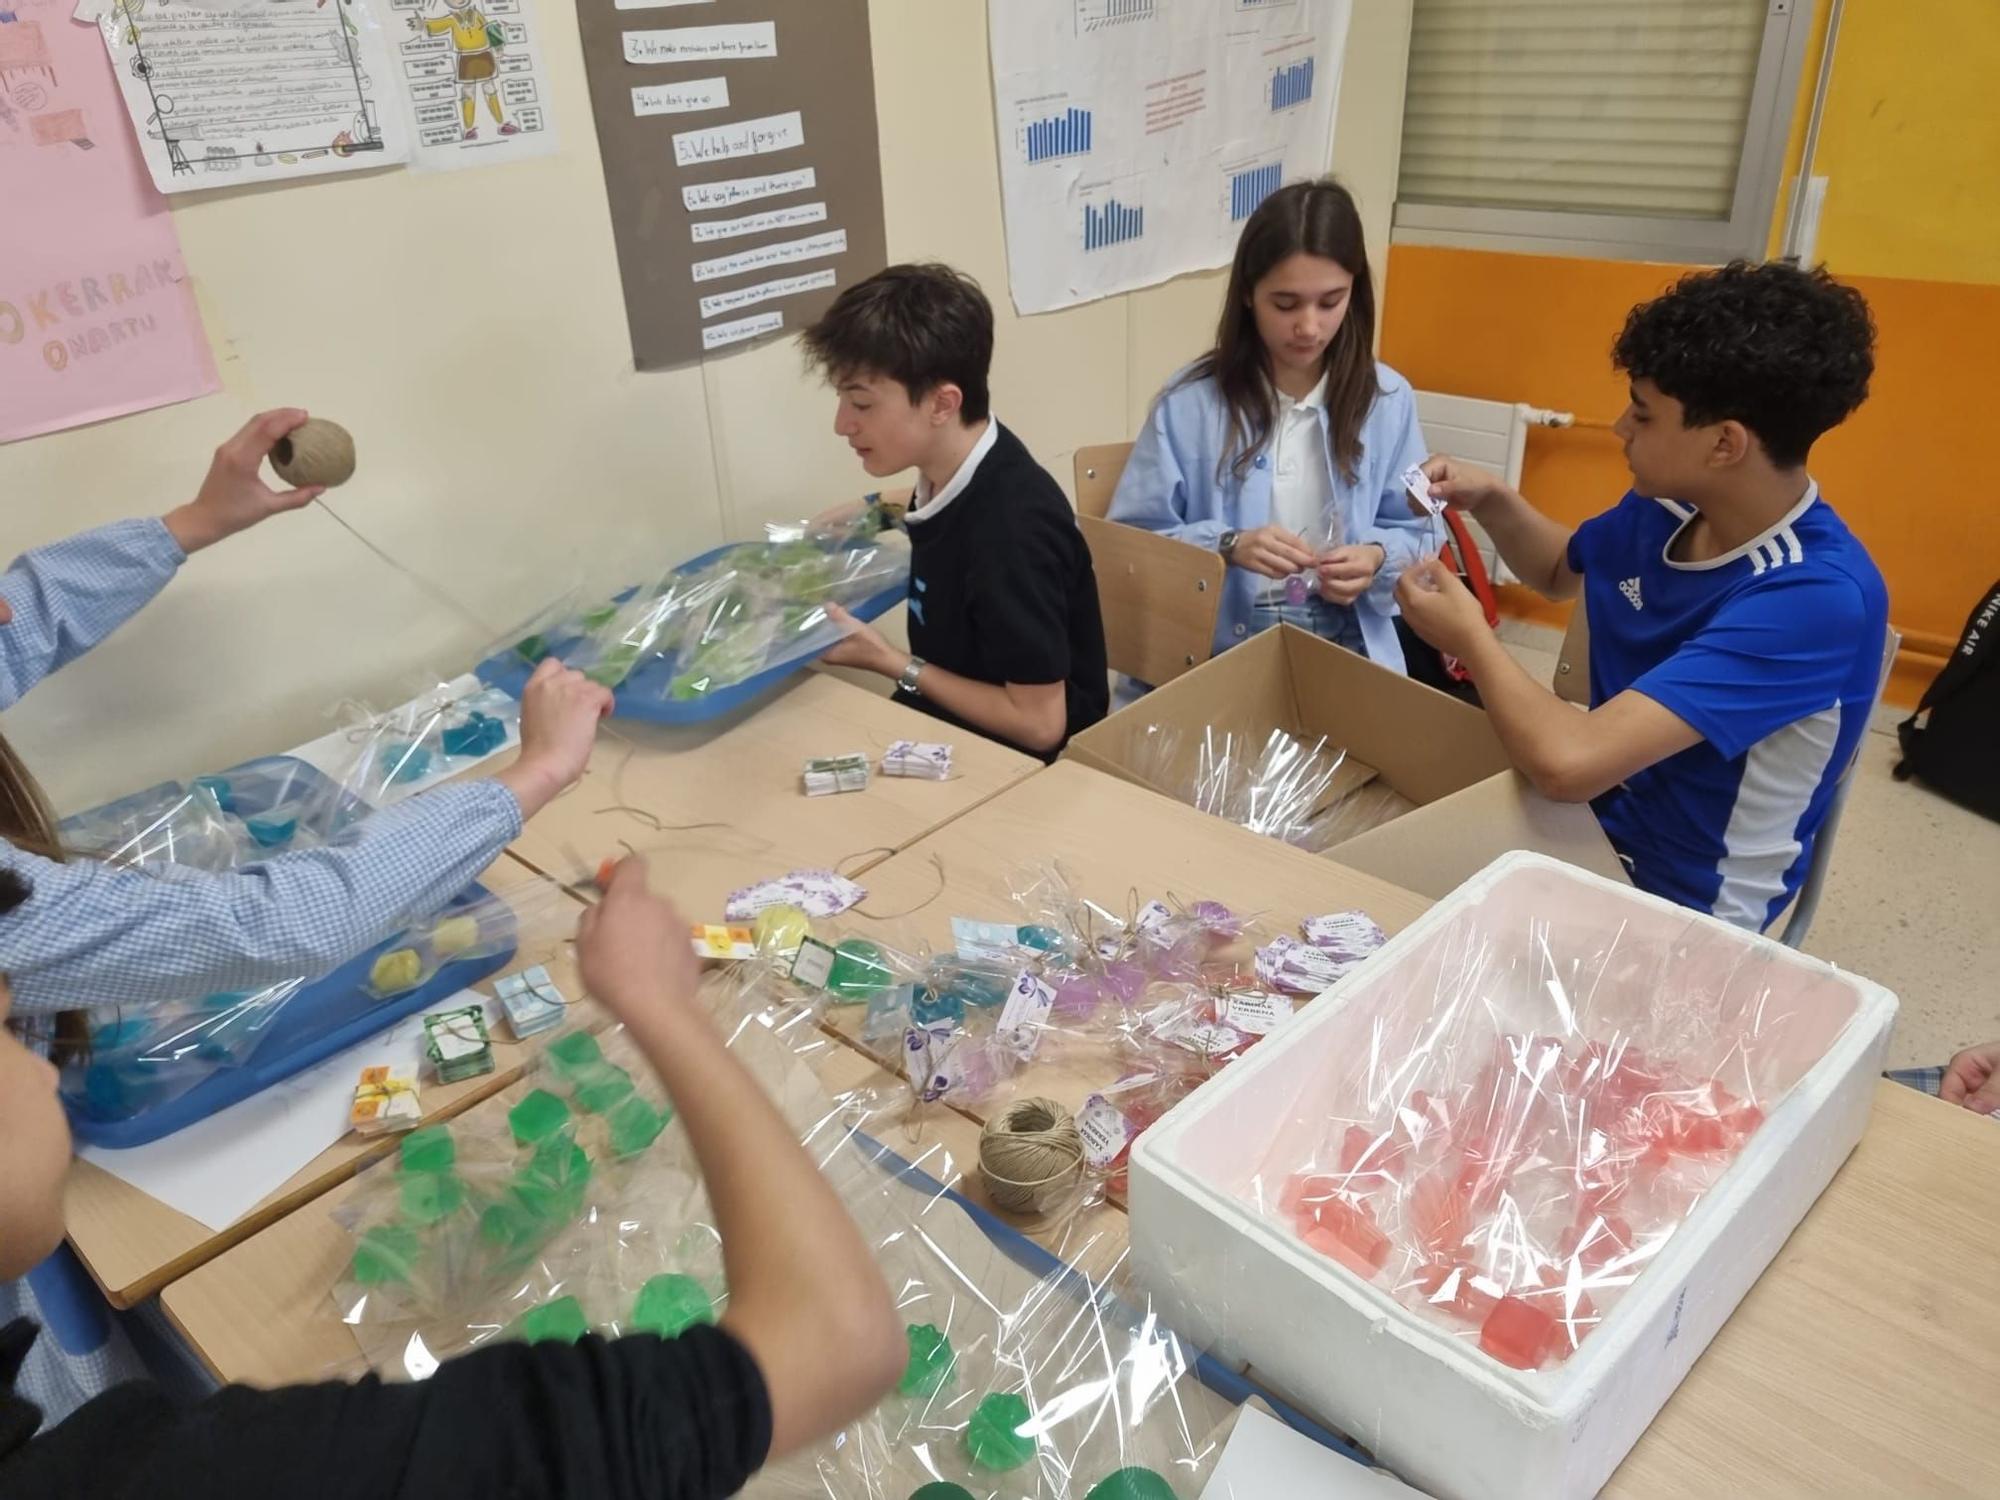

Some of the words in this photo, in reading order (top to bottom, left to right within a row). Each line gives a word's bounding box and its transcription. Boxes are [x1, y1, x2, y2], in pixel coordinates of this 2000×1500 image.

[712, 135, 729, 156] help
[732, 130, 749, 150] and
[1618, 580, 1644, 611] adidas
[1962, 629, 1980, 656] AIR
